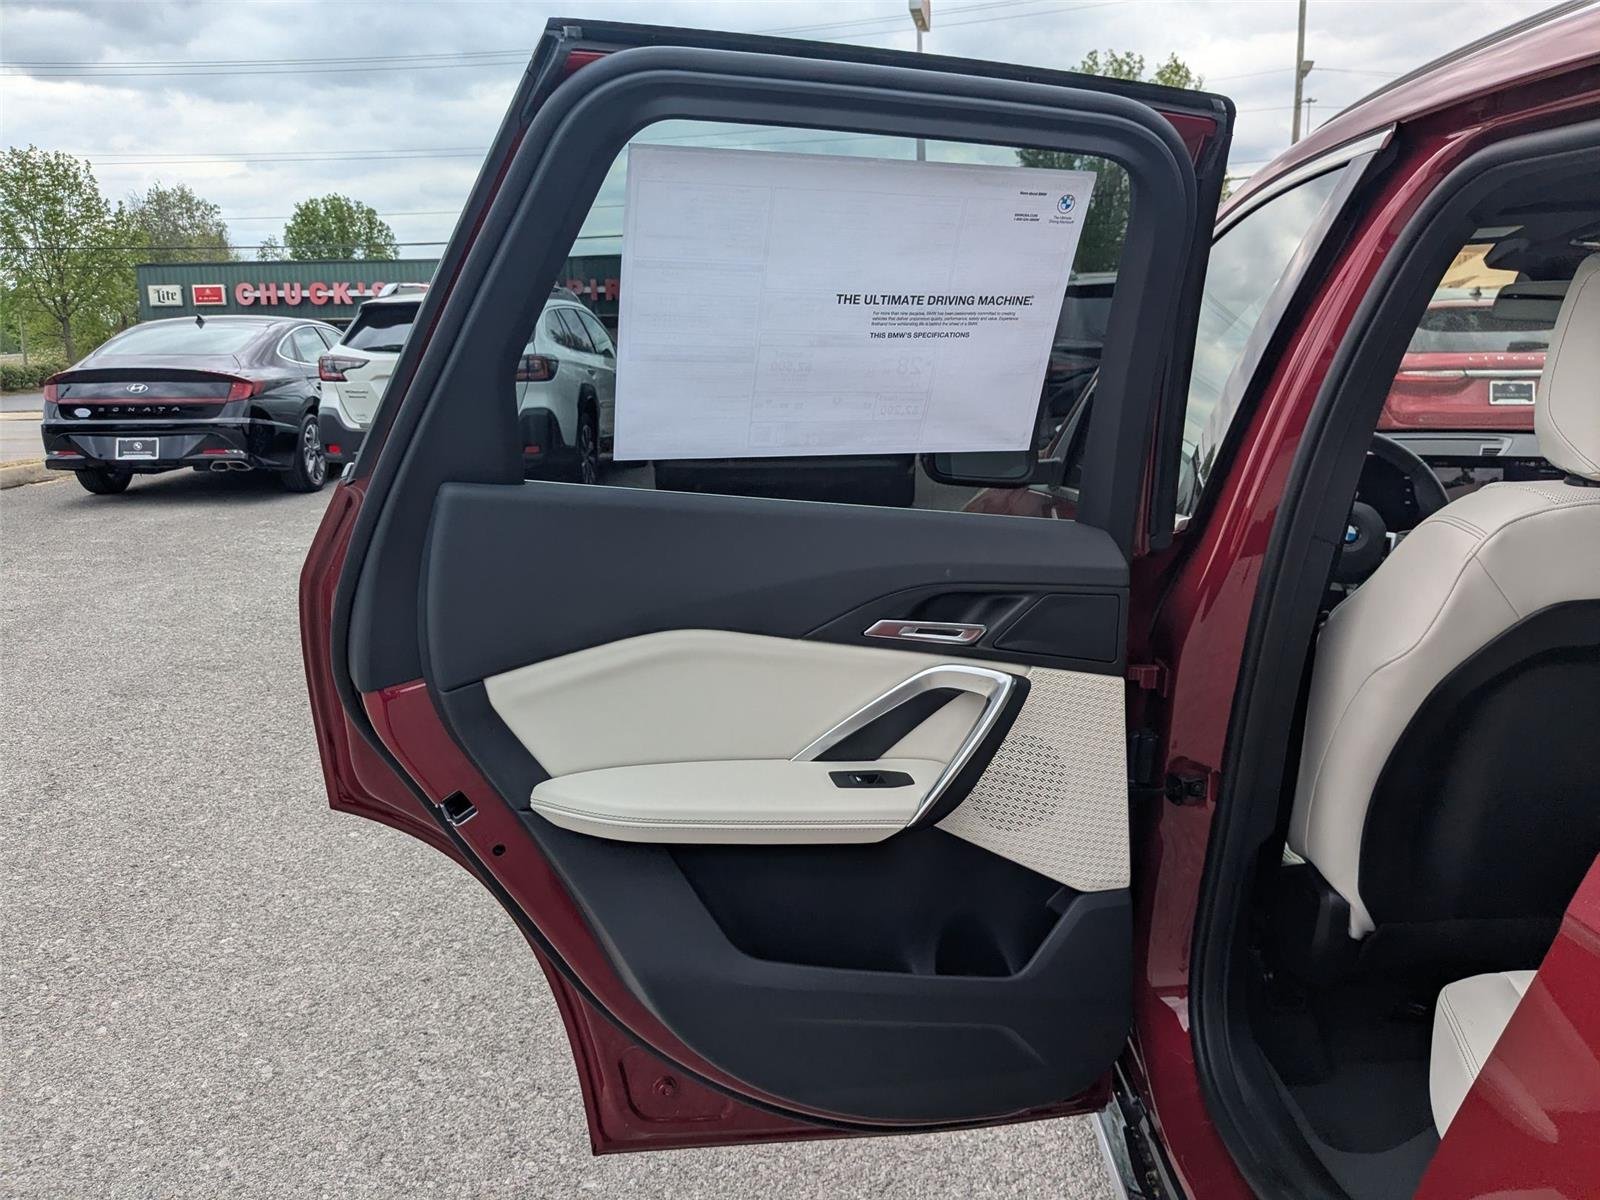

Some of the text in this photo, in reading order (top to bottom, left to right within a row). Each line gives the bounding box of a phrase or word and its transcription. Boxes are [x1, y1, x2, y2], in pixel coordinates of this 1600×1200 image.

[154, 287, 177, 303] Lite
[836, 294, 861, 305] THE
[864, 294, 924, 305] ULTIMATE
[927, 296, 975, 306] DRIVING
